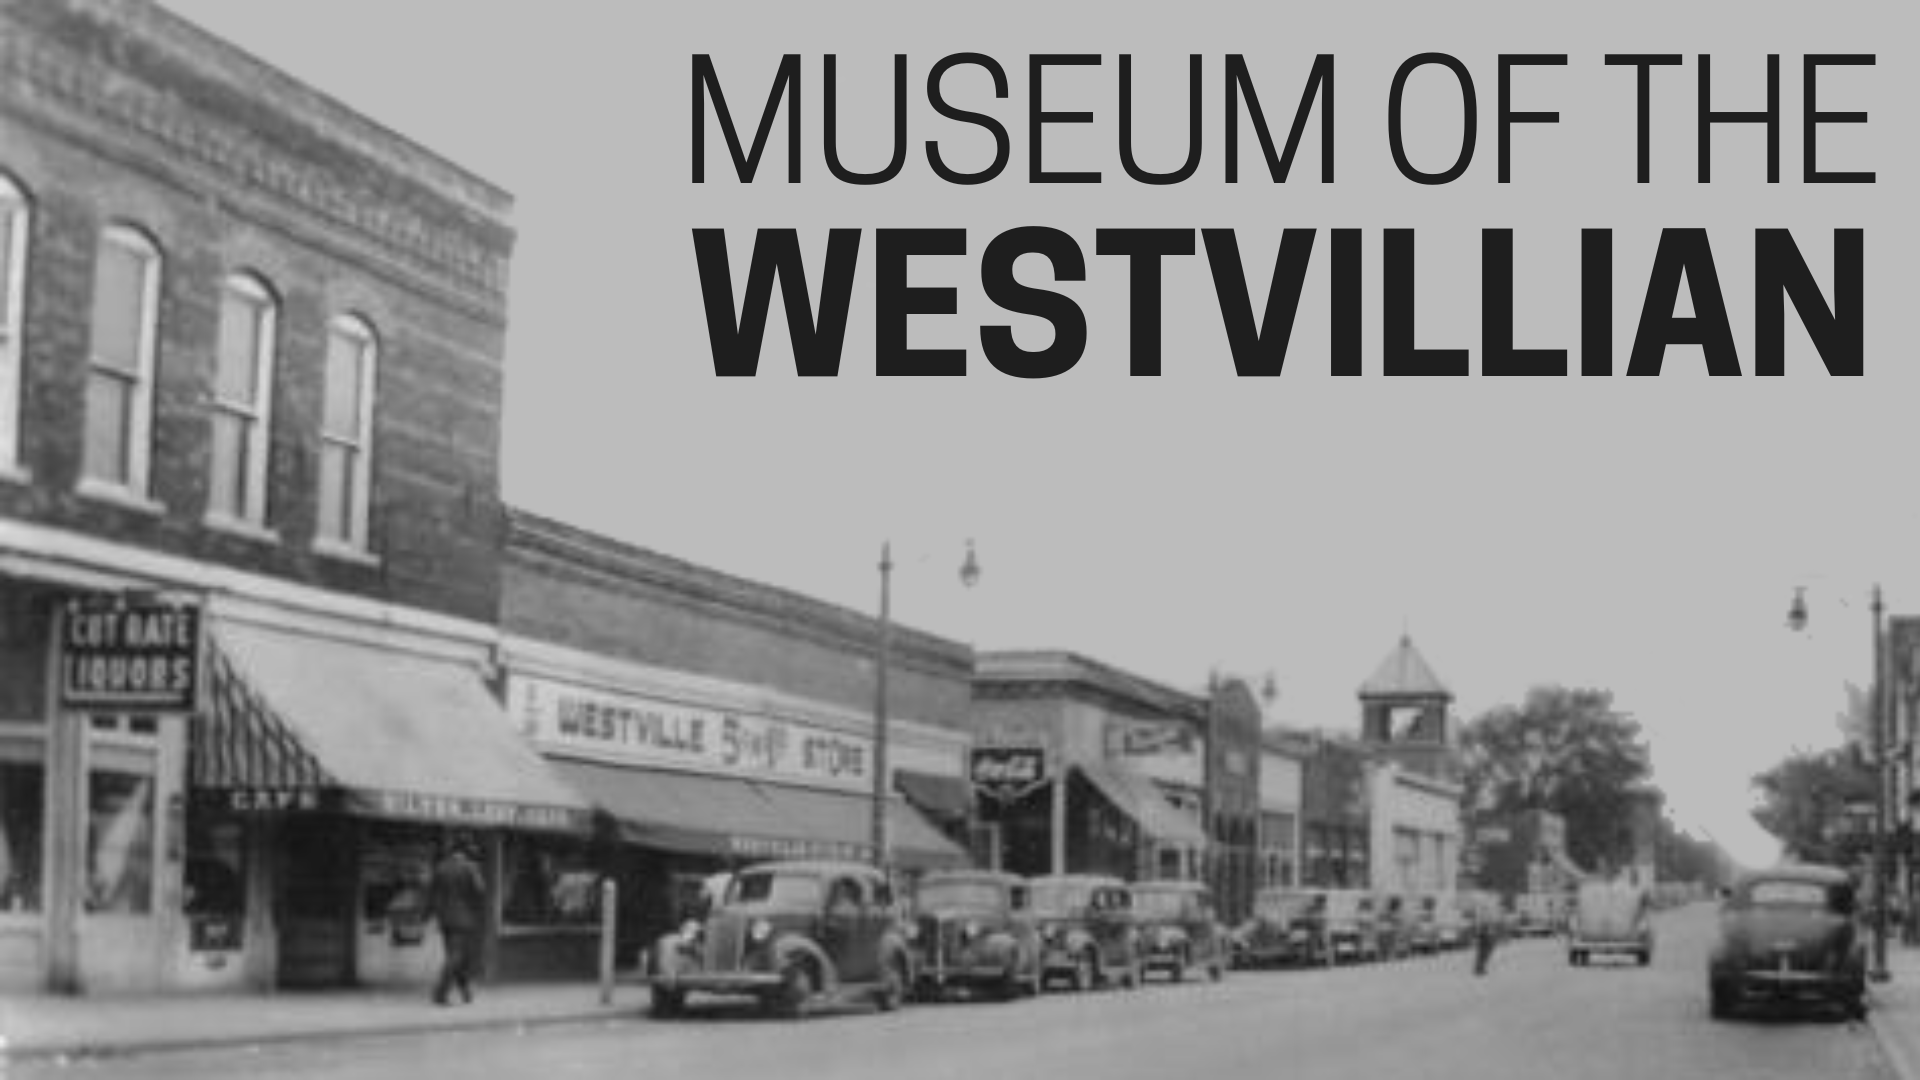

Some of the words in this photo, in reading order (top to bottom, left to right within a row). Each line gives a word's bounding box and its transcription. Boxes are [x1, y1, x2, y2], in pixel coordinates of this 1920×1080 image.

[70, 612, 119, 646] CUT
[124, 613, 190, 647] RATE
[64, 653, 190, 700] LIQUORS
[557, 696, 705, 753] WESTVILLE
[803, 735, 863, 777] STORE
